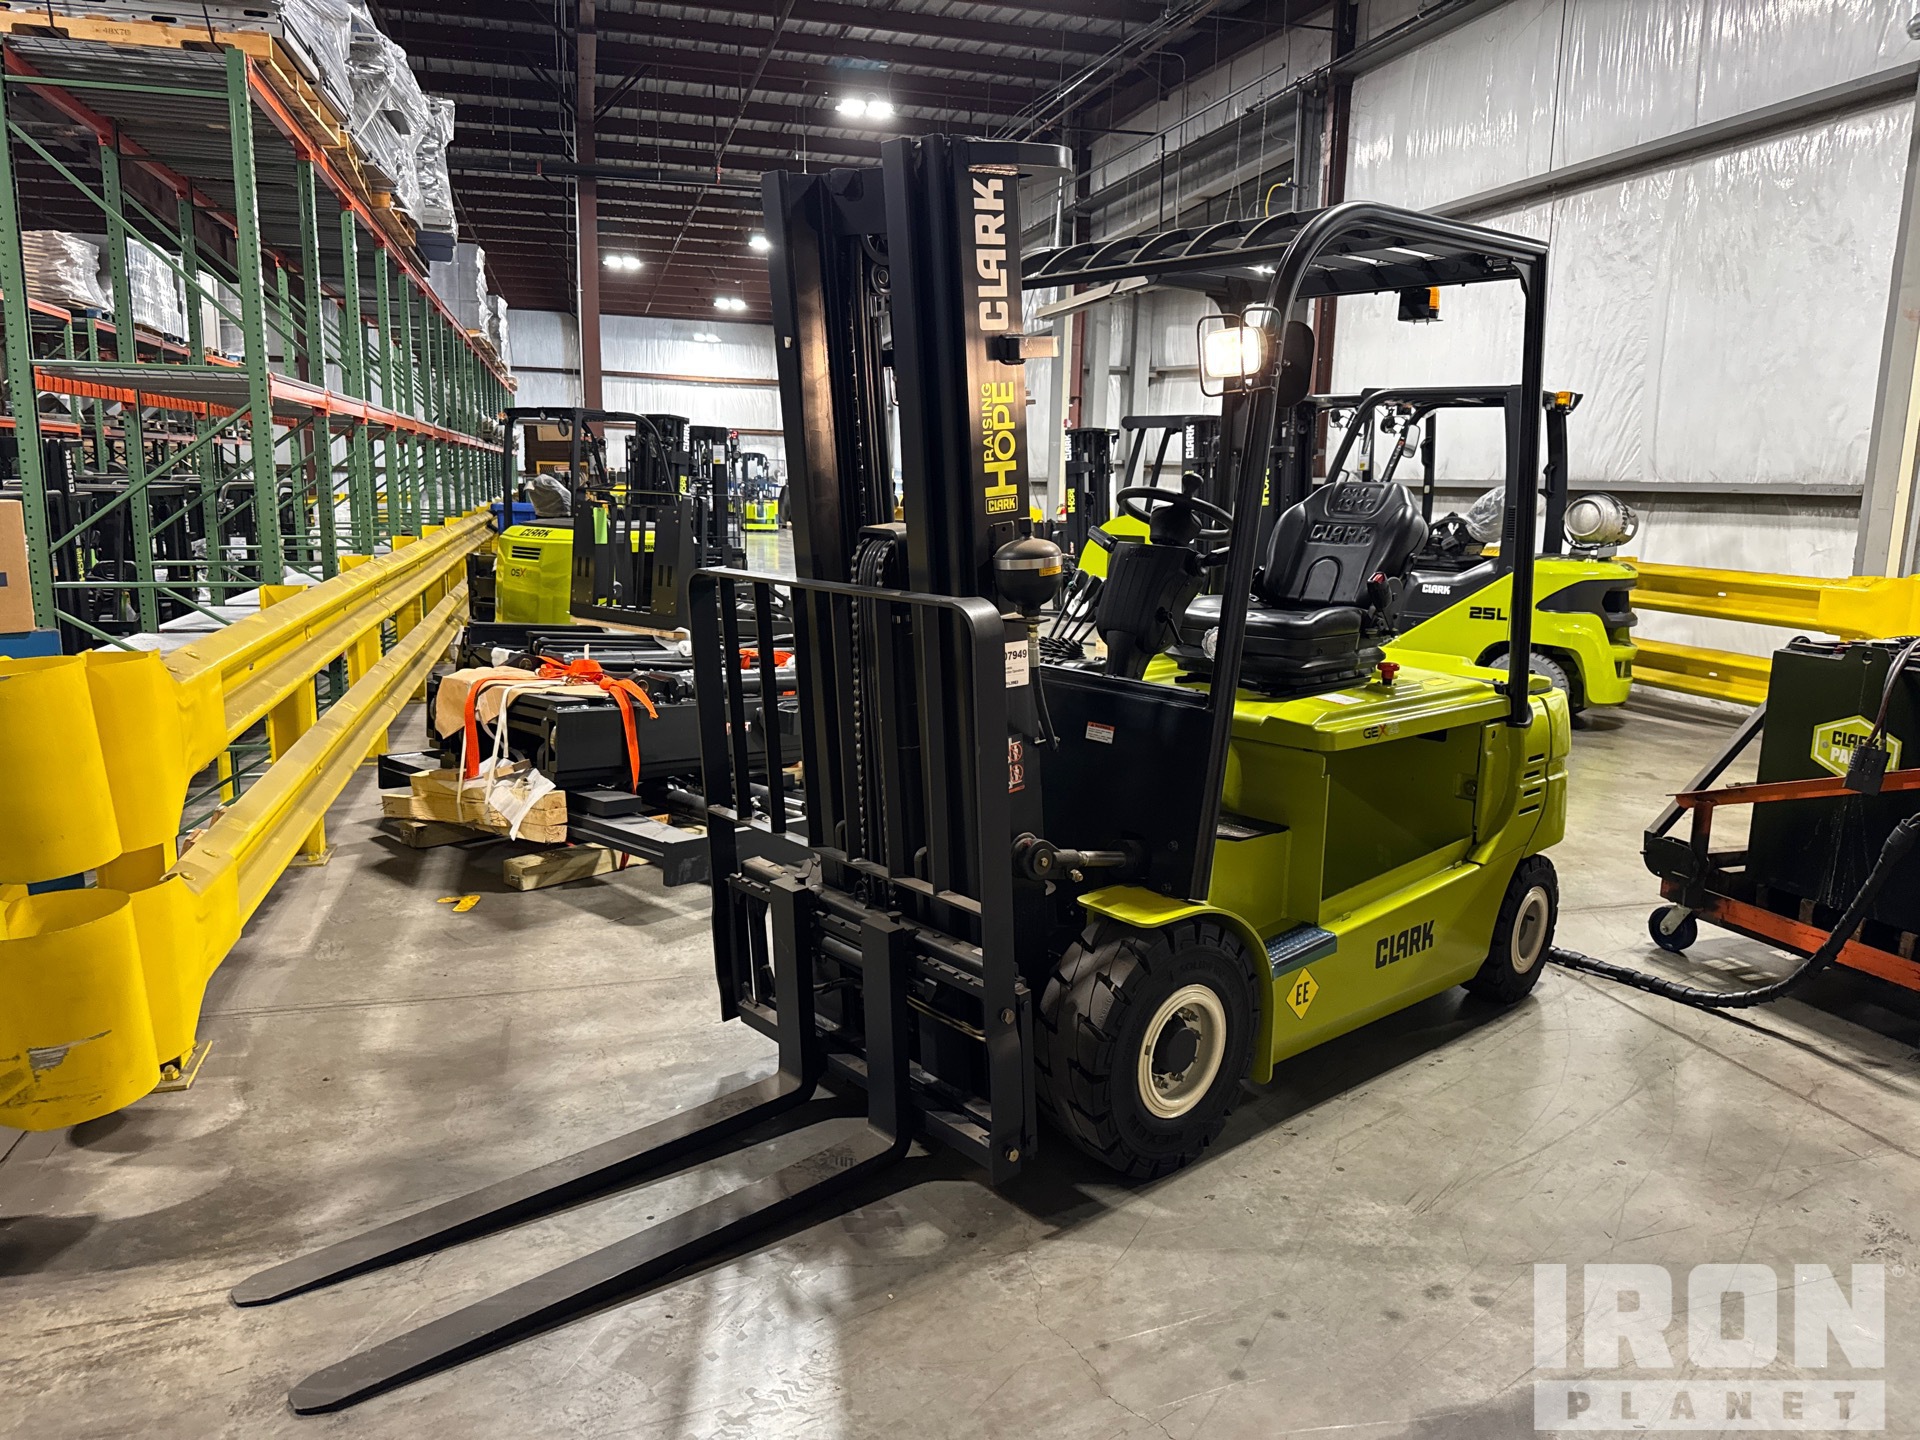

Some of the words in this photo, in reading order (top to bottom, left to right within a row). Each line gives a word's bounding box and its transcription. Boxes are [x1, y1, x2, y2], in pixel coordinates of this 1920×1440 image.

[972, 177, 1010, 332] CLARK
[981, 382, 994, 461] RAISING
[682, 423, 691, 453] CLARK
[984, 381, 1018, 498] HOPE
[1185, 424, 1195, 459] CLARK
[65, 449, 75, 493] CLARK
[988, 498, 1016, 512] CLARK
[519, 528, 552, 538] CLARK
[1310, 523, 1372, 545] CLARK
[1421, 583, 1451, 595] CLARK
[1469, 606, 1508, 621] 25L
[1375, 920, 1435, 969] CLARK
[1295, 981, 1310, 1006] EE
